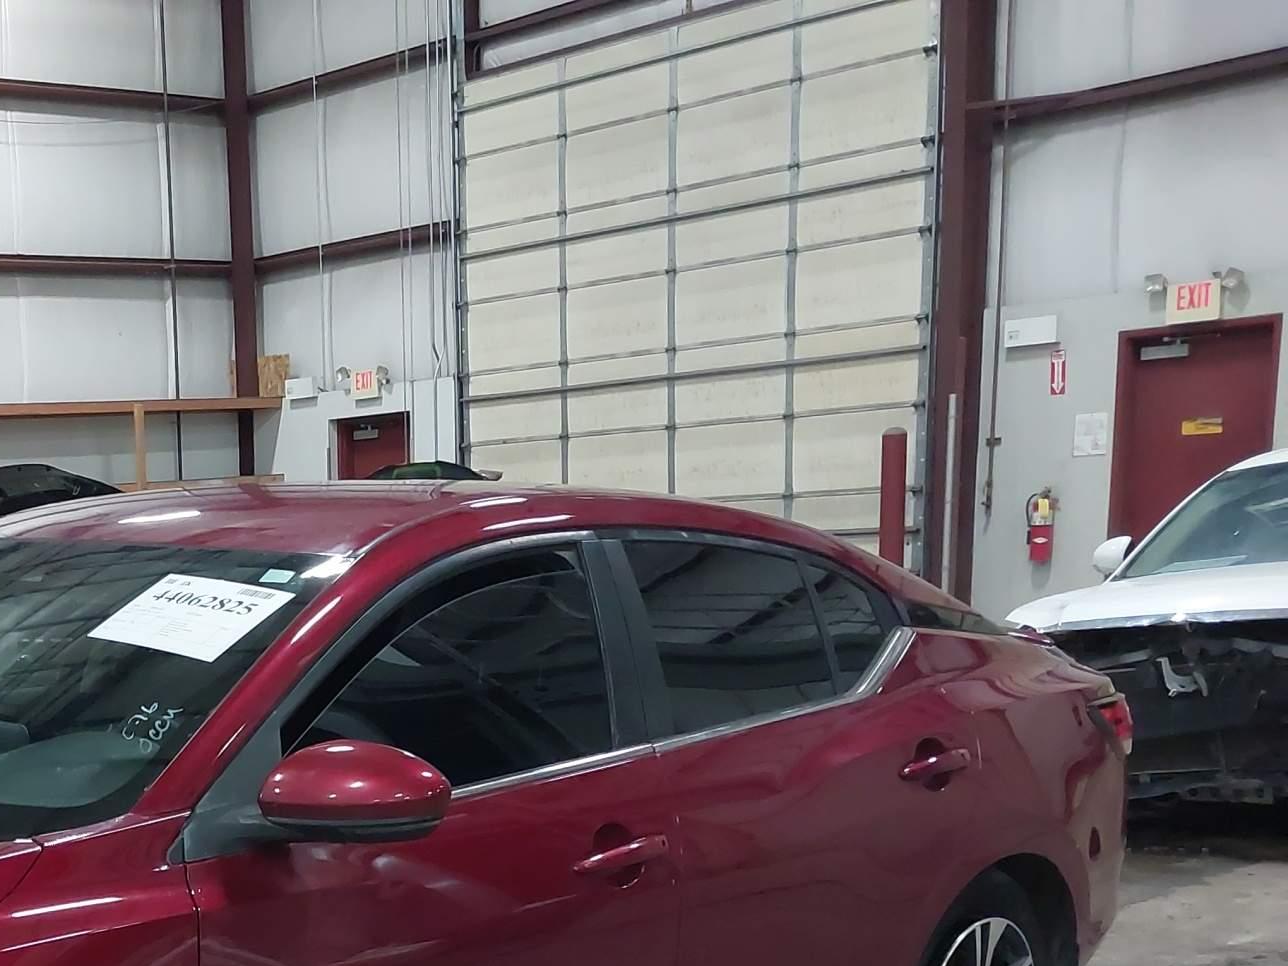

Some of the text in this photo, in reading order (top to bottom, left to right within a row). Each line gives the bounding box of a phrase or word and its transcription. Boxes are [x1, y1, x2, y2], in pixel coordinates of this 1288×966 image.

[1177, 282, 1212, 310] EXIT
[355, 371, 373, 390] EXIT
[152, 589, 259, 616] 44062825
